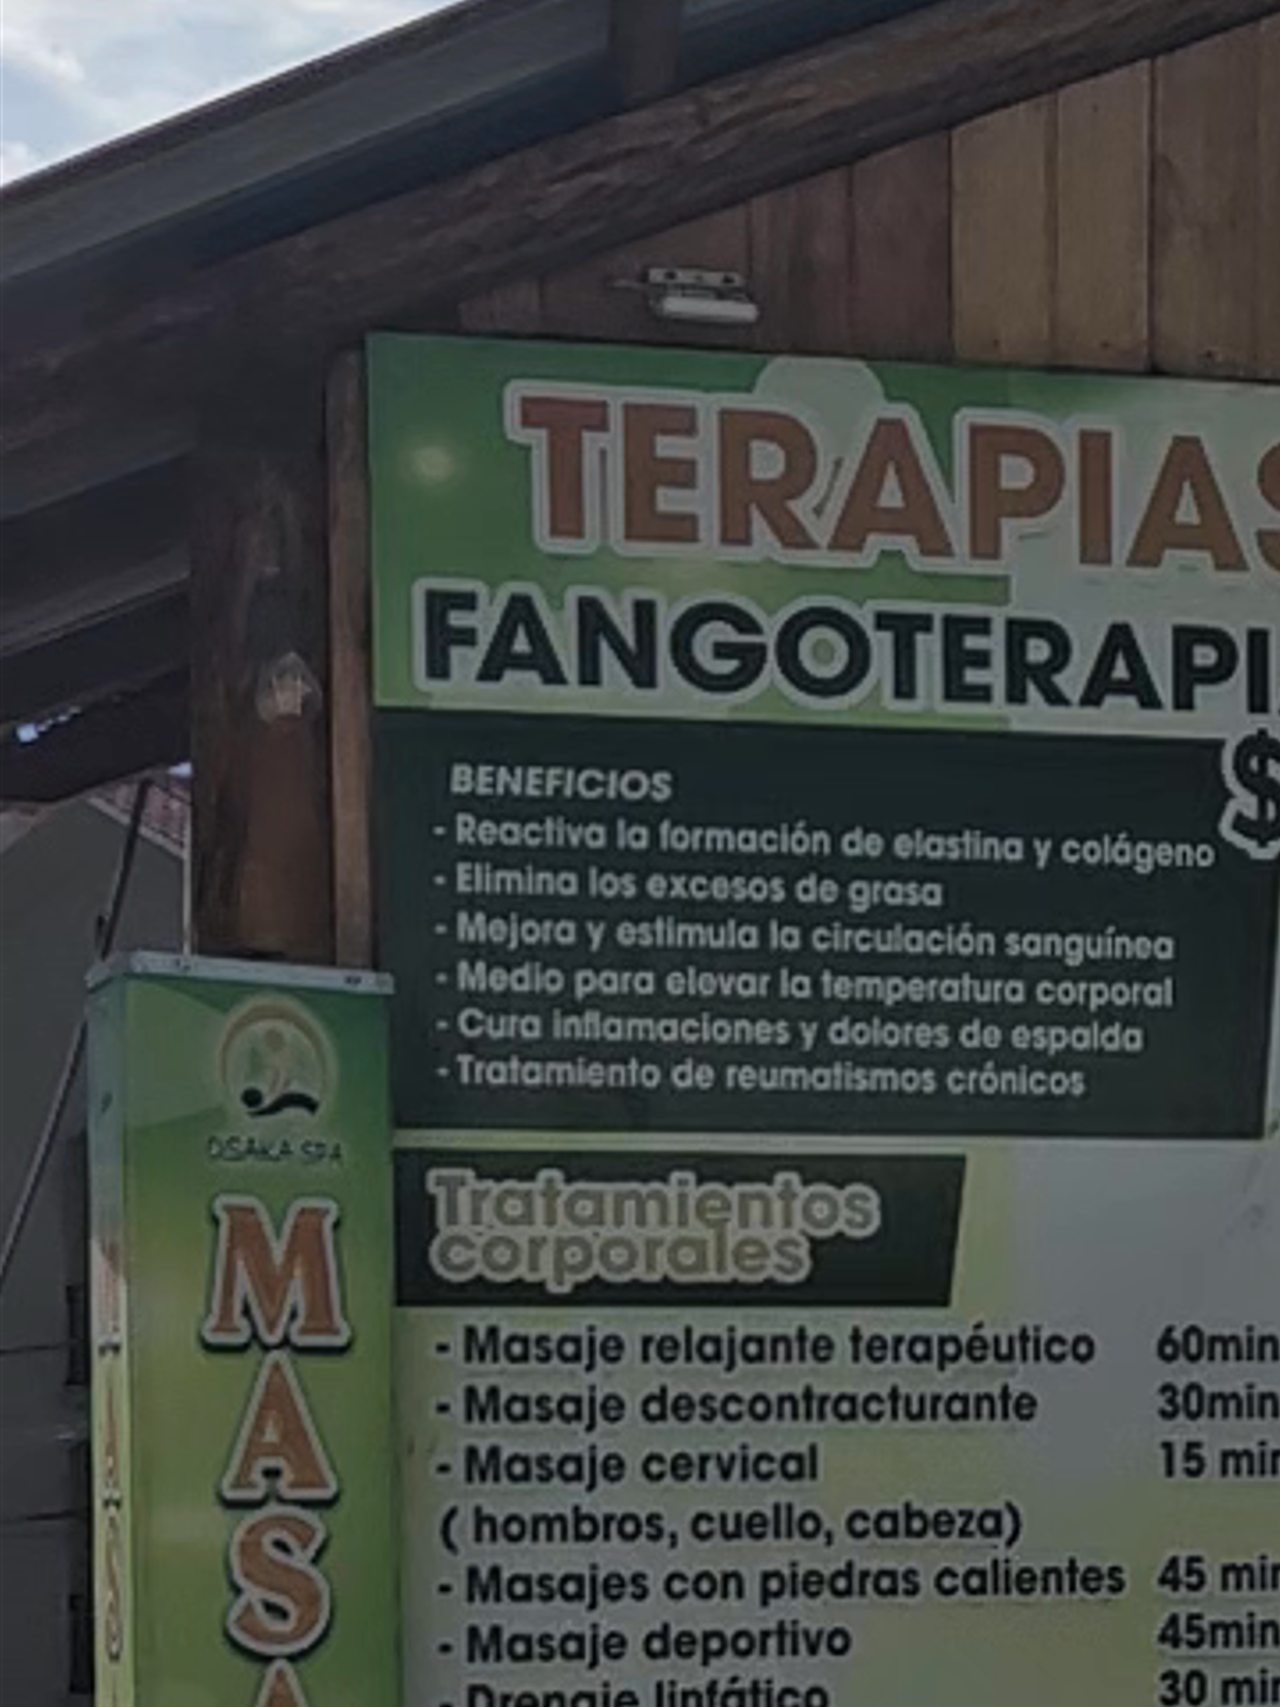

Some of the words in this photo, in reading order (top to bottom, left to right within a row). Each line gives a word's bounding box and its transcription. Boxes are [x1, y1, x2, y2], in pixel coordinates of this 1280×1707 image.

[451, 765, 671, 801] BENEFICIOS
[457, 813, 606, 848] Reactiva
[618, 819, 648, 849] la
[660, 820, 830, 854] formación
[841, 827, 883, 856] de
[894, 830, 1023, 861] elastina
[1034, 840, 1051, 868] y
[1062, 833, 1214, 874] colágeno
[457, 863, 578, 895] Elimina
[590, 867, 636, 898] los
[647, 875, 785, 902] excesos
[796, 874, 838, 903] de
[848, 881, 942, 912] grasa
[457, 1054, 661, 1087] Tratamiento
[671, 1058, 714, 1089] de
[727, 1062, 936, 1093] reumatismos
[947, 1061, 1084, 1095] crónicos
[433, 1173, 877, 1234] Tratamientos
[433, 1229, 808, 1289] corporales
[464, 1325, 624, 1372] Masaje
[642, 1326, 834, 1372] relajante
[850, 1322, 1094, 1371] terapéutico
[1157, 1325, 1279, 1363] 60min
[465, 1385, 625, 1433] Masaje
[641, 1384, 1037, 1423] descontracturante
[1159, 1382, 1279, 1420] 30min
[465, 1445, 625, 1492] Masaje
[642, 1444, 817, 1482] cervical
[1161, 1442, 1205, 1477] 15
[691, 1503, 833, 1546] cuello,
[846, 1502, 1021, 1548] cabeza)
[467, 1563, 649, 1611] Masajes
[664, 1571, 744, 1600] con
[760, 1560, 920, 1607] piedras
[935, 1558, 1125, 1596] calientes
[1158, 1556, 1205, 1592] 45
